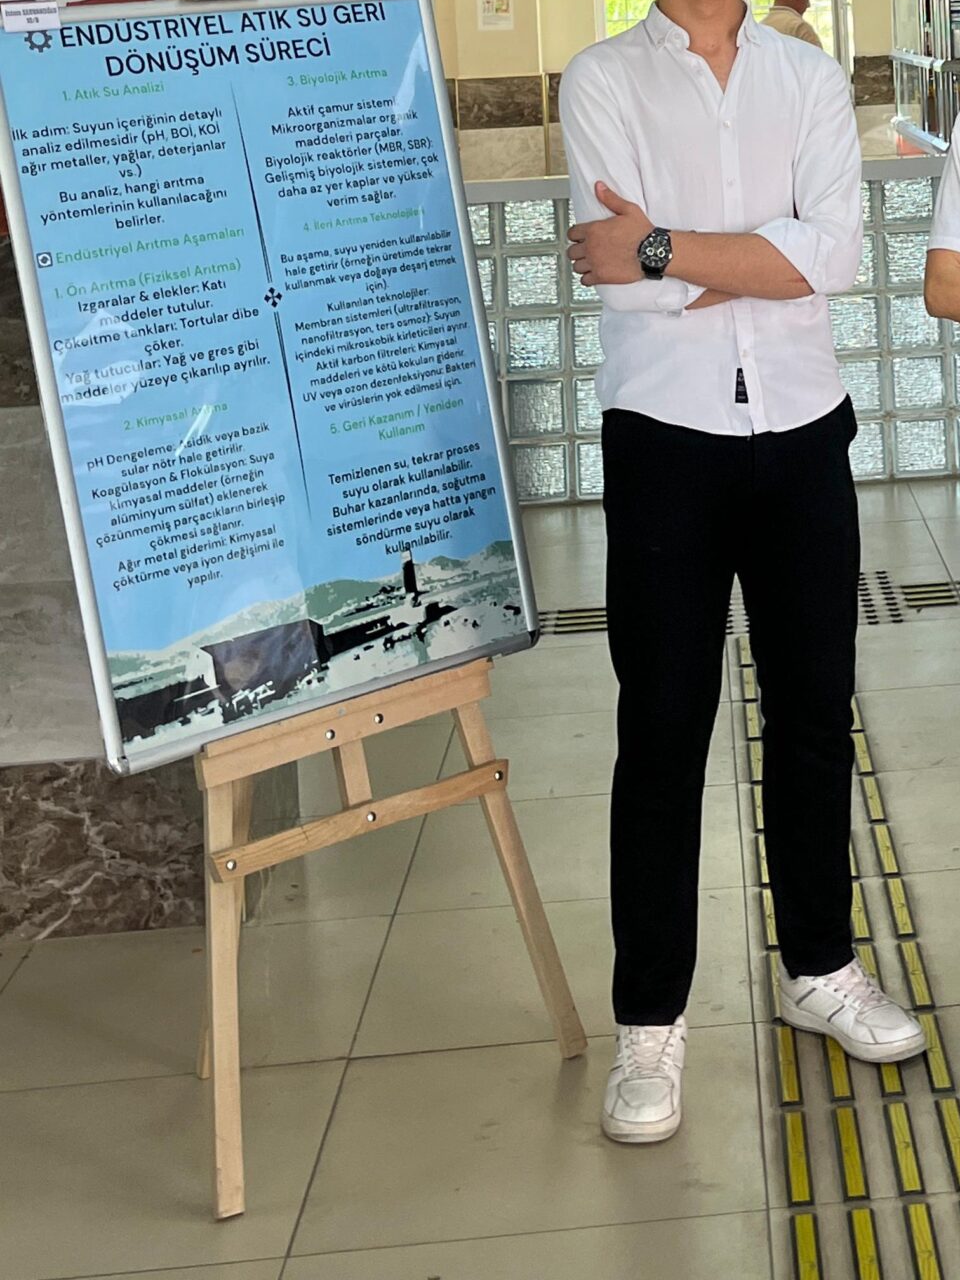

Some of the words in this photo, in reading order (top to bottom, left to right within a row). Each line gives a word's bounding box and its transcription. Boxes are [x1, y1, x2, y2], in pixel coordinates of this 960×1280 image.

[61, 14, 232, 48] ENDÜSTRİYEL
[241, 9, 291, 32] ATIK
[298, 6, 326, 27] SU
[106, 42, 239, 76] DÖNÜŞÜM
[246, 34, 330, 63] SÜRECİ
[12, 129, 28, 140] İlk
[32, 125, 70, 138] adım:
[72, 121, 114, 135] Suyun
[116, 112, 176, 131] içeriğinin
[179, 107, 222, 121] detaylı
[22, 141, 61, 156] analiz
[64, 132, 138, 151] edilmesidir
[141, 129, 168, 145] (pH,
[170, 124, 196, 139] BOİ,
[198, 121, 220, 135] KOİ
[21, 161, 46, 176] ağır
[50, 154, 109, 170] metaller,
[112, 149, 154, 165] yağlar,
[158, 139, 226, 156] deterjanlar
[59, 191, 77, 203] Bu
[81, 185, 122, 200] analiz,
[124, 179, 160, 194] hangi
[163, 176, 204, 189] arıtma
[328, 463, 391, 485] Temizlenen
[393, 459, 409, 469] su,
[411, 451, 443, 465] tekrar
[446, 442, 480, 460] proses
[342, 485, 369, 498] suyu
[372, 474, 405, 491] olarak
[407, 459, 472, 483] kullanılabilir.
[332, 502, 365, 518] Buhar
[367, 484, 439, 509] kazanlarında,
[442, 473, 486, 491] soğutma
